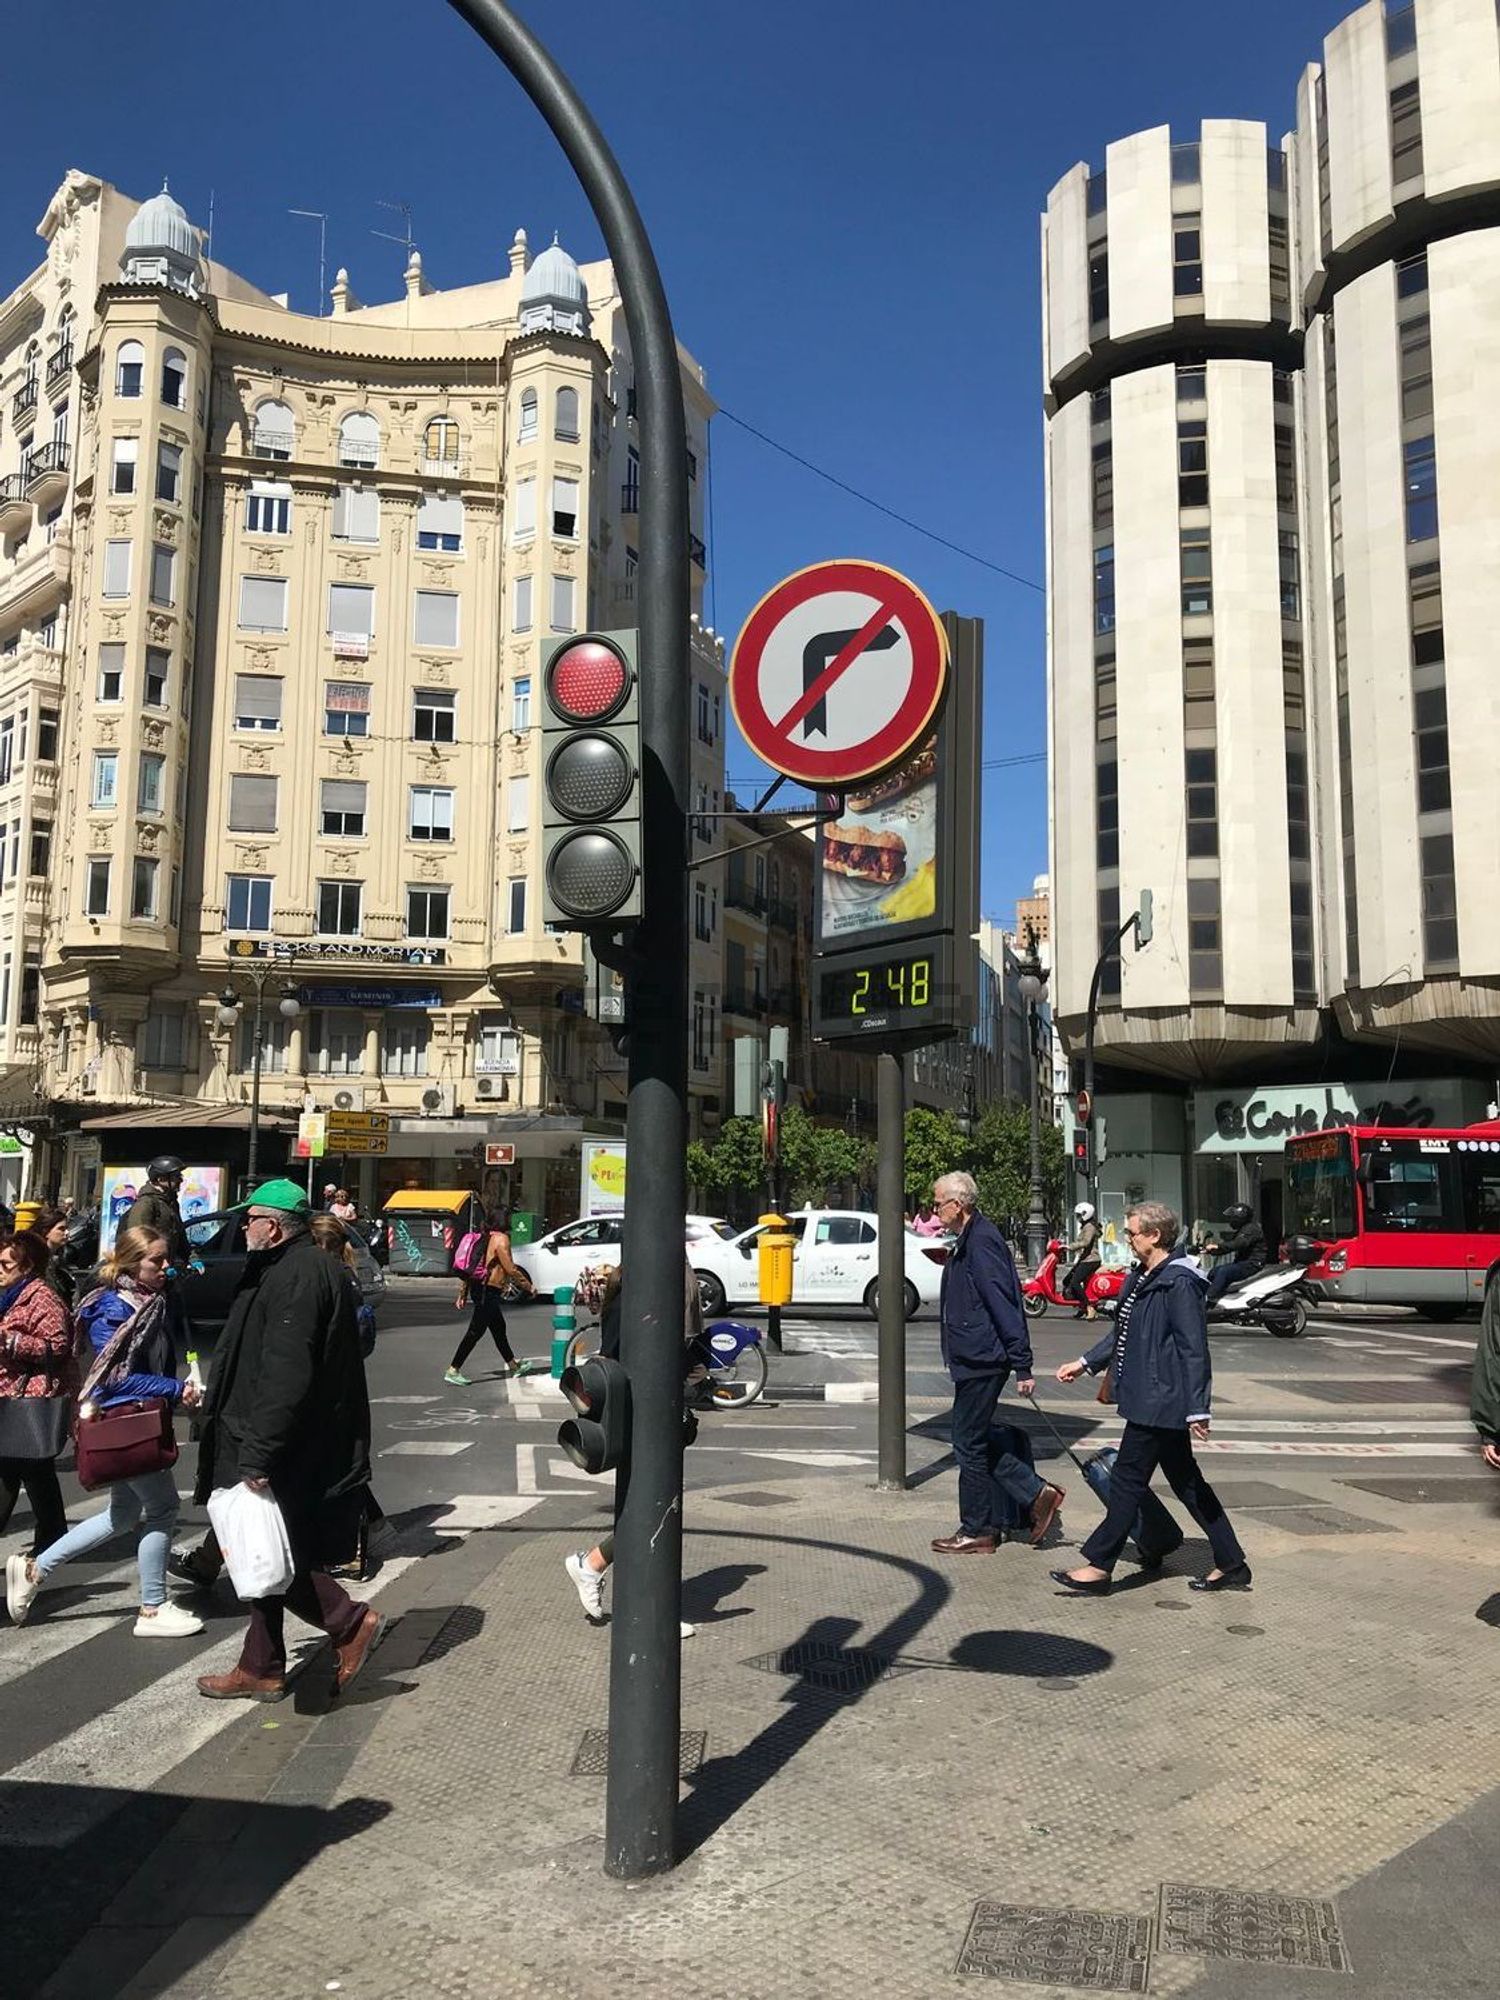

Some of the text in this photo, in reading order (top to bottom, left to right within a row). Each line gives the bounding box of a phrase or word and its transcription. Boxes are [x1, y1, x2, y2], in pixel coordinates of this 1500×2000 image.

[259, 940, 438, 957] BRICKS AND MORTAR
[1215, 1100, 1247, 1140] El
[1247, 1101, 1320, 1140] Corte
[1418, 1139, 1450, 1148] EMT
